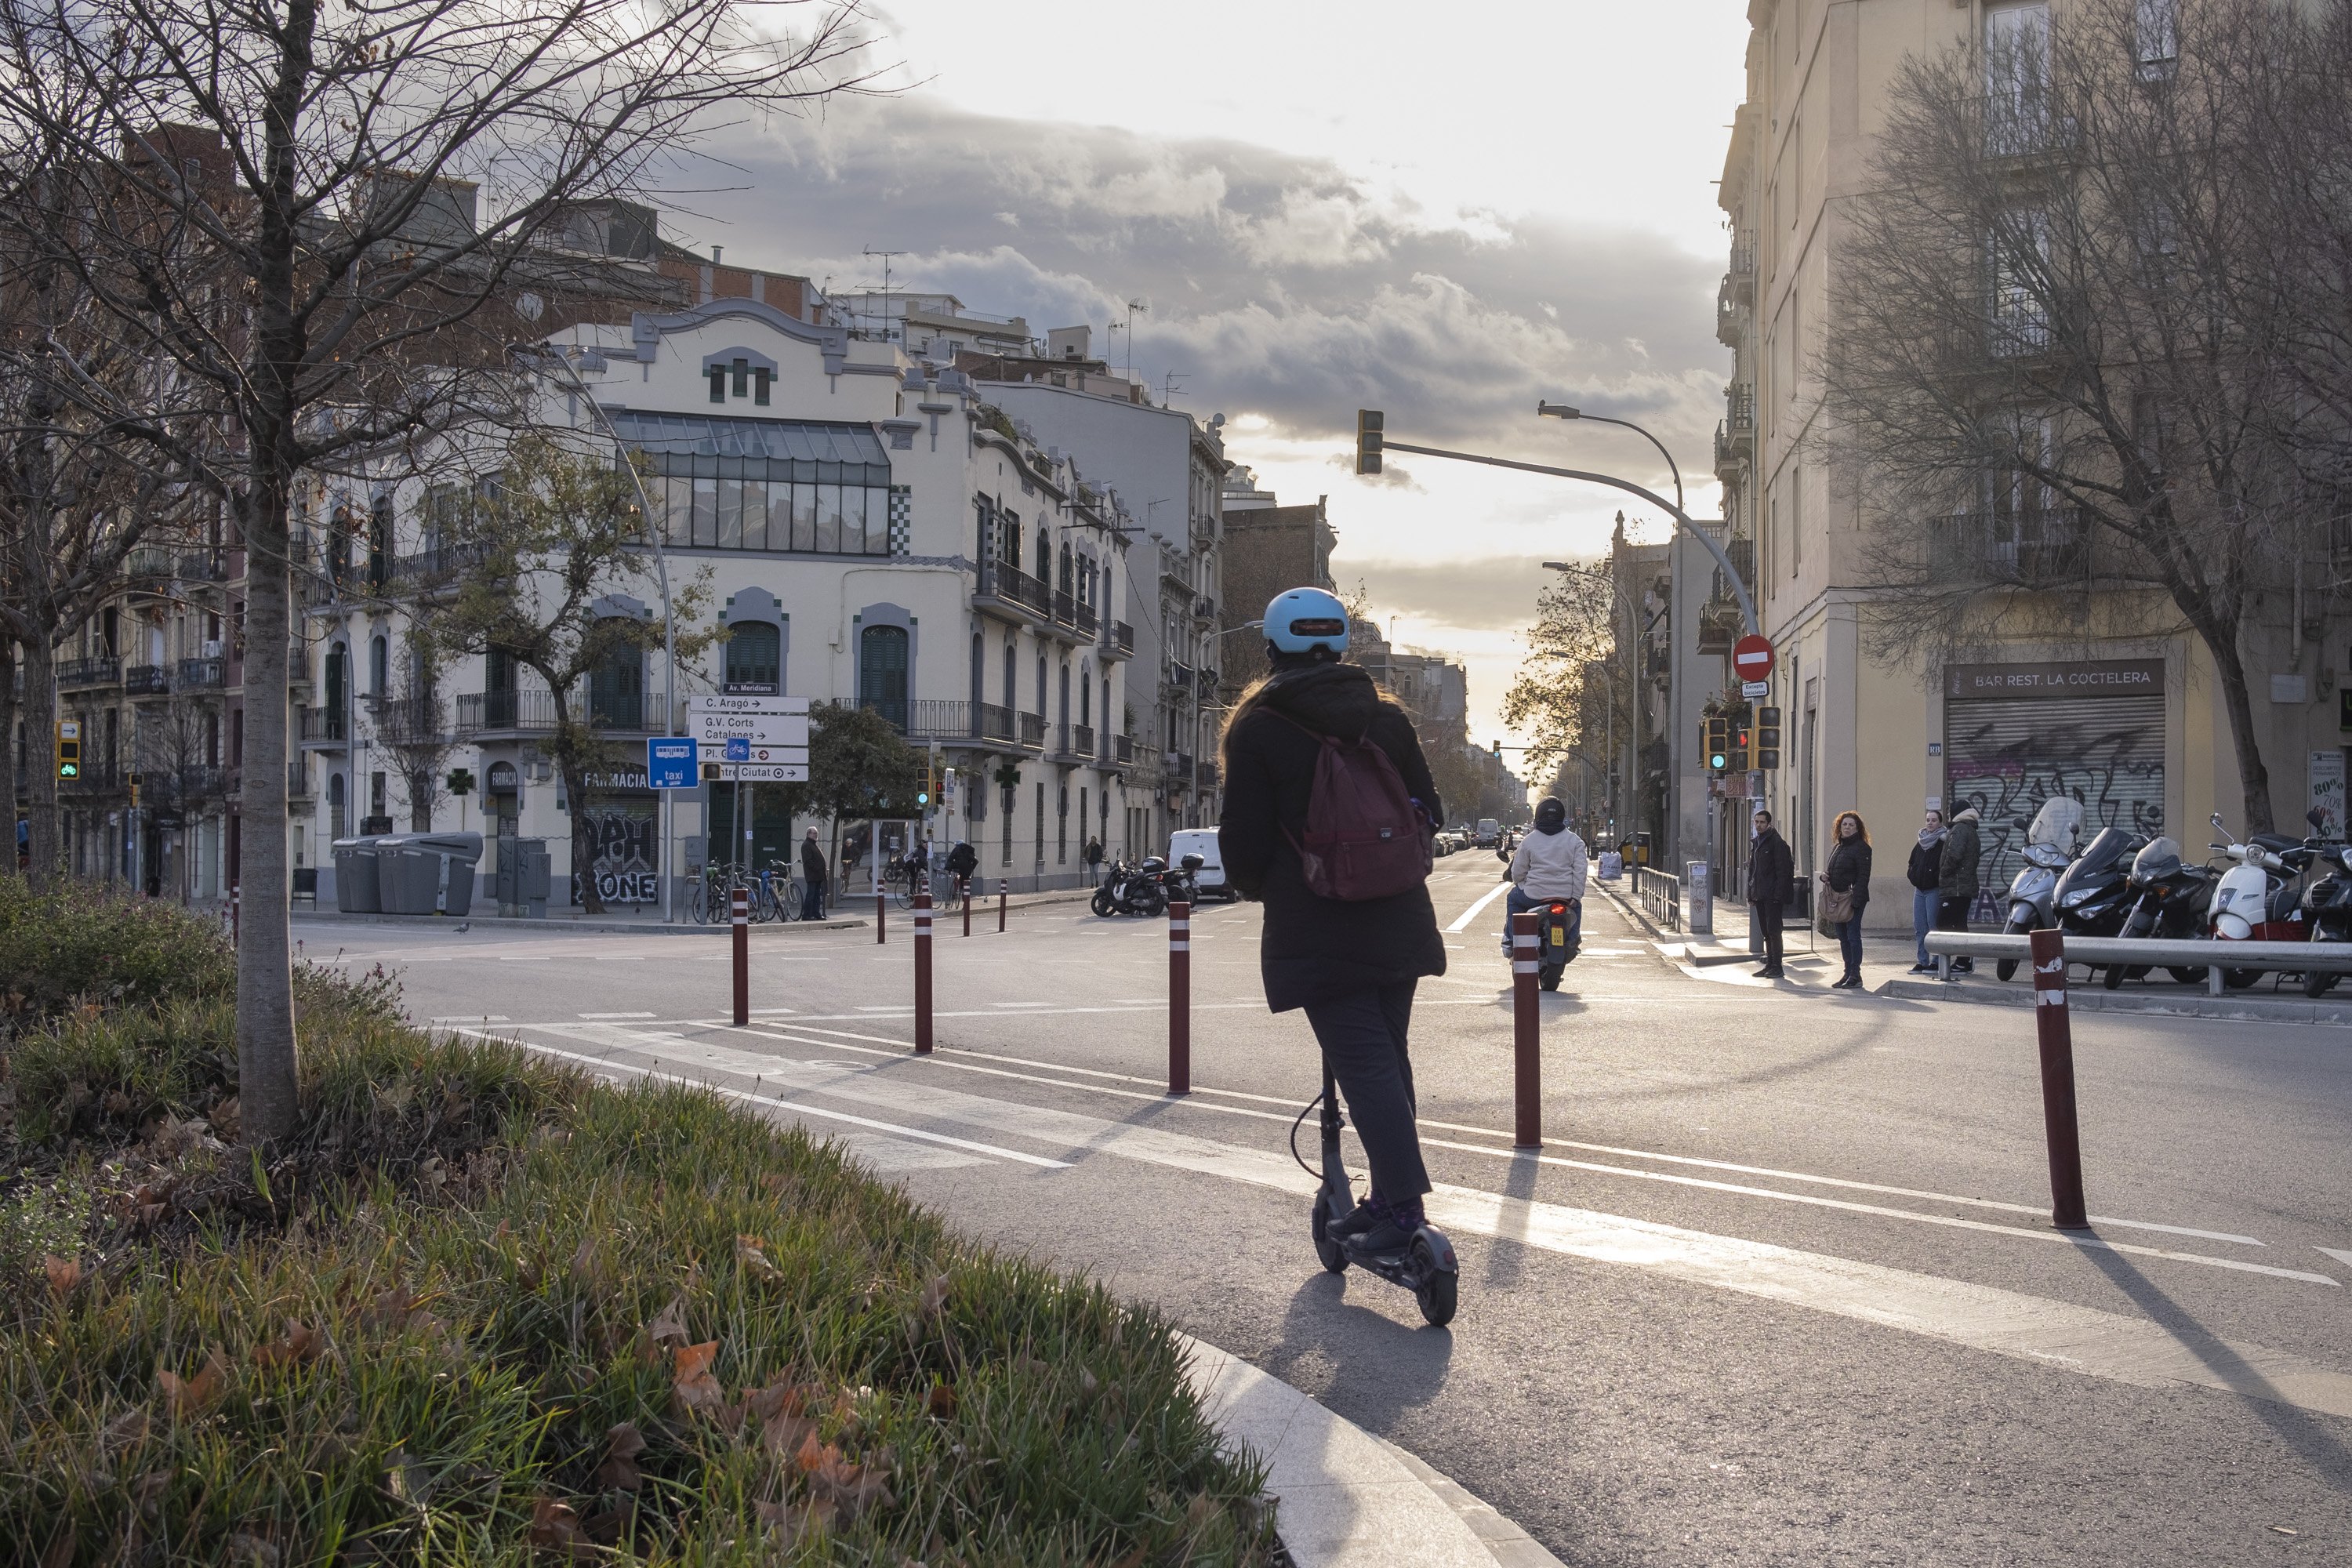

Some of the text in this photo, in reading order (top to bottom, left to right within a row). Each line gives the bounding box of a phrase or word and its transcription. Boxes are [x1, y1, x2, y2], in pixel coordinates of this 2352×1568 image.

[1976, 672, 2151, 687] BAR REST. LA COCTELERA
[706, 698, 749, 710] C. Aragó
[706, 717, 754, 728] G.V. Corts
[706, 729, 754, 739] Catalanes
[706, 749, 717, 758] Pl.
[492, 768, 517, 786] FARMÀCIA
[665, 770, 683, 780] taxi
[742, 768, 771, 777] Ciutat
[2314, 776, 2343, 796] 80%
[2323, 794, 2342, 809] 70%
